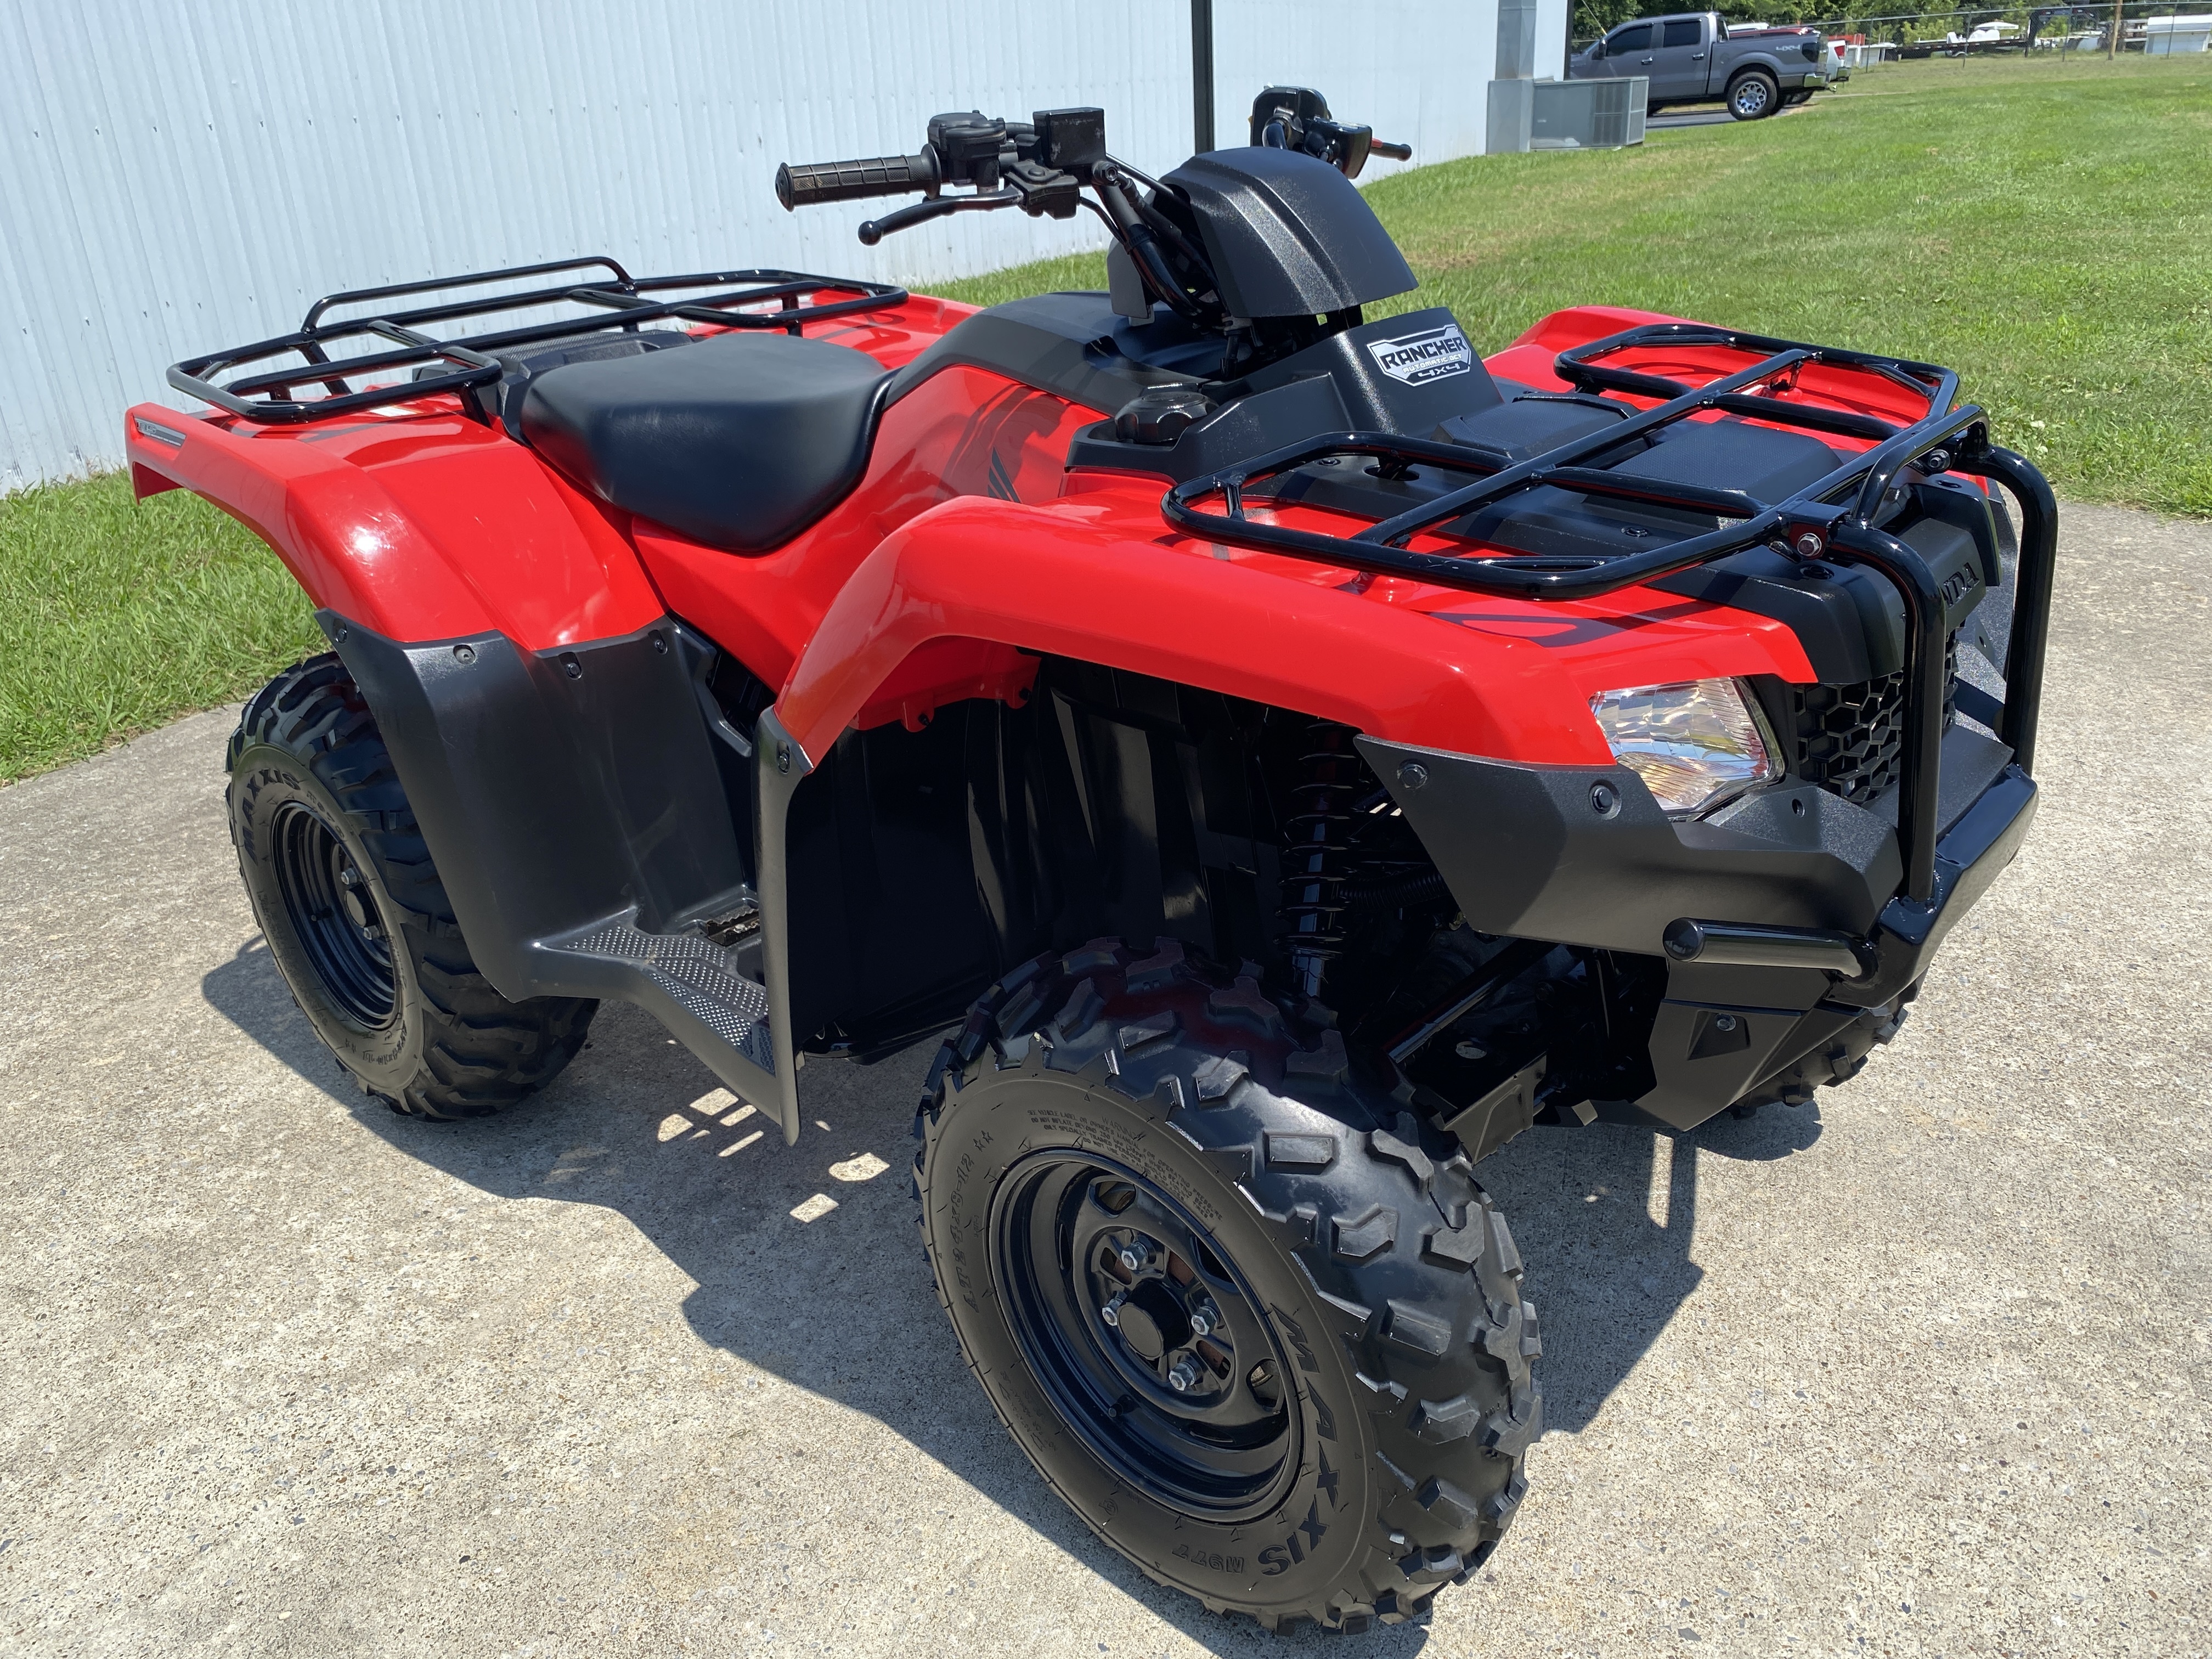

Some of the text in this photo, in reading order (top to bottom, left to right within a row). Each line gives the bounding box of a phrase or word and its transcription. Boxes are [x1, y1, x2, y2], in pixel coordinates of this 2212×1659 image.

[1379, 336, 1467, 370] RANCHER
[1402, 353, 1462, 374] AUTOMATIC DCT
[242, 768, 301, 866] MAXXIS
[1060, 1111, 1077, 1120] LABEL
[1143, 1148, 1155, 1160] FOR
[1158, 1159, 1190, 1188] OPERATING
[1168, 1173, 1192, 1197] SEATING
[1258, 1303, 1340, 1576] MAXXIS
[1172, 1544, 1245, 1575] M977
